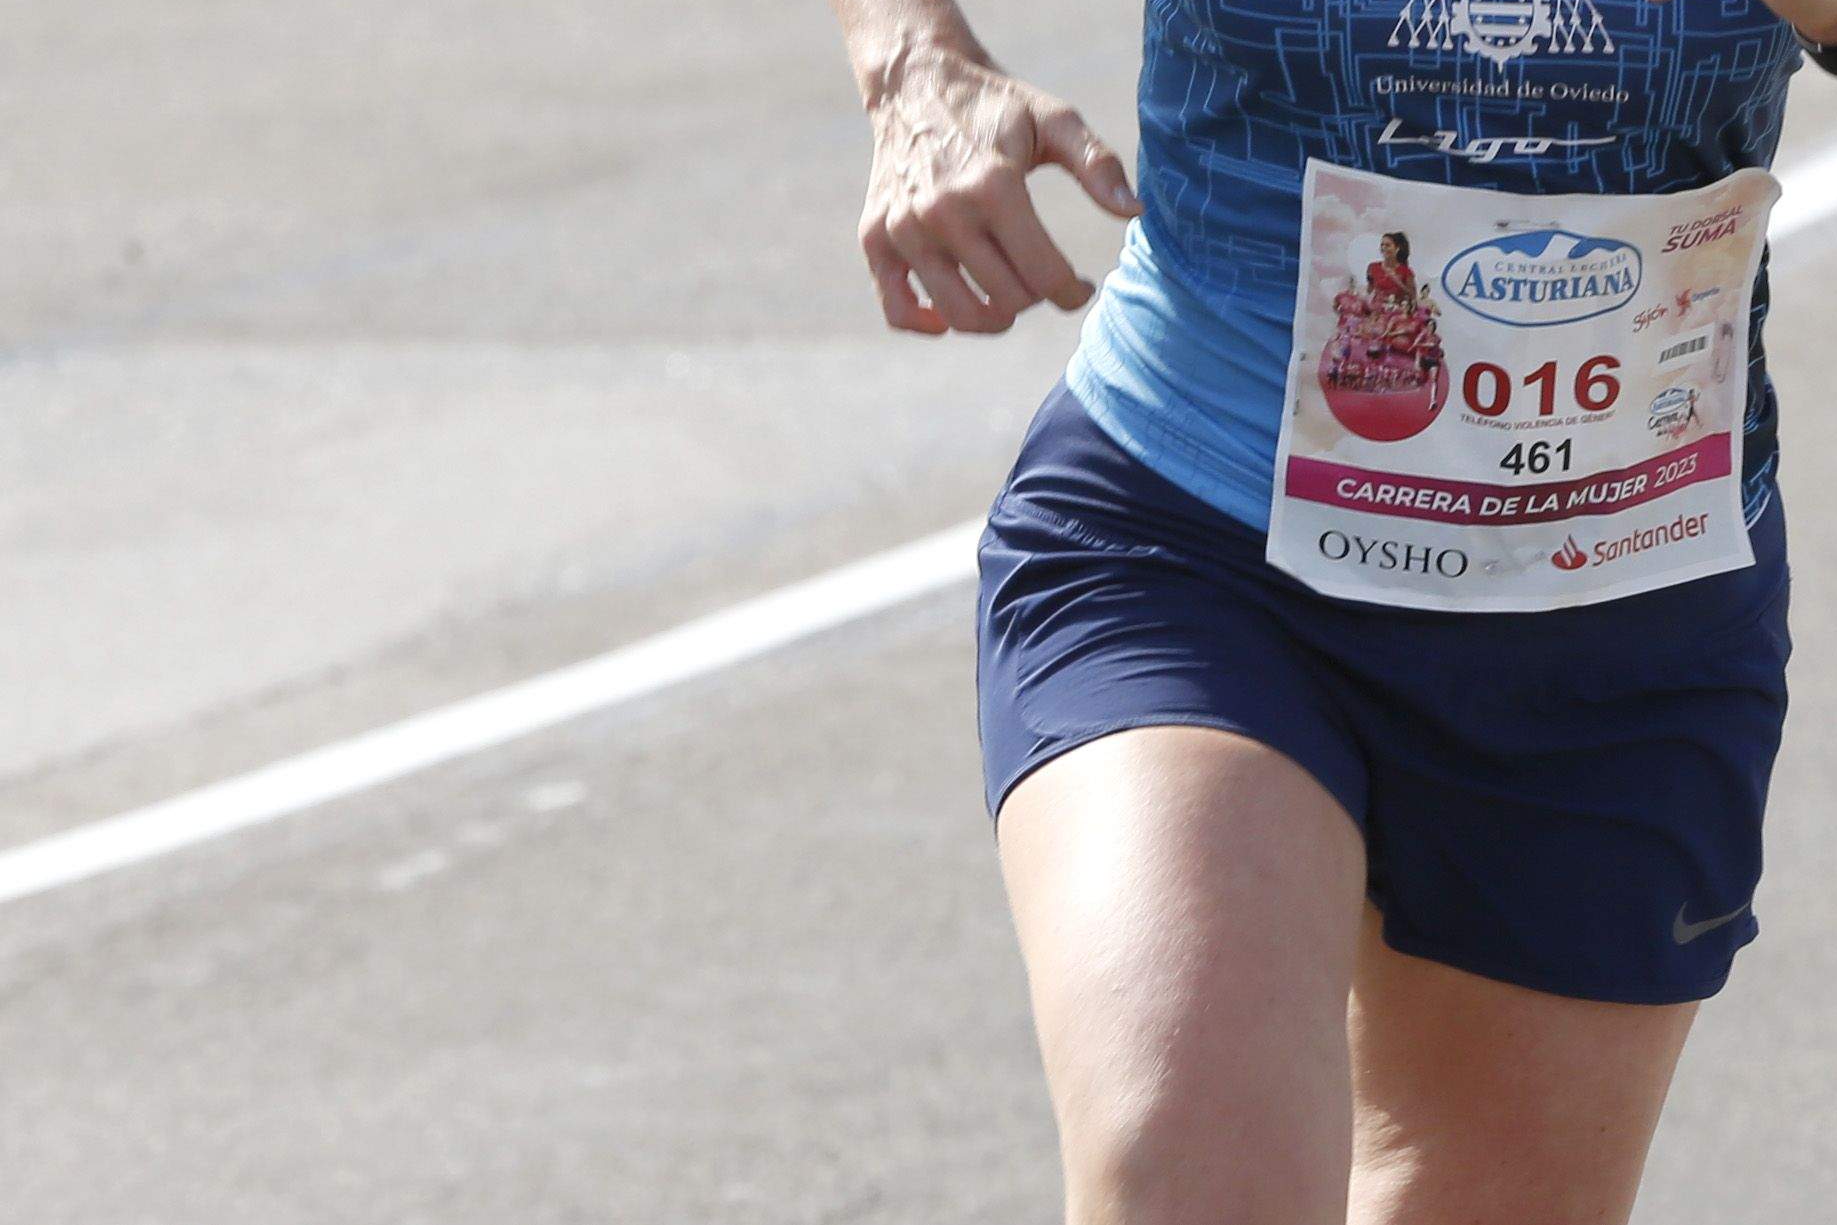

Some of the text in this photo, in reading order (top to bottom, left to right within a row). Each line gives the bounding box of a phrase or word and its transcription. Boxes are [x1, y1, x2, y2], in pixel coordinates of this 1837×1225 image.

[1376, 75, 1629, 104] Universidad de Oviedo
[1661, 218, 1736, 253] SUMA
[1670, 205, 1743, 235] TU DORSAL
[1494, 260, 1563, 275] CENTRAL
[1463, 354, 1621, 417] 016
[1565, 416, 1579, 426] DE
[1500, 438, 1572, 475] 461
[1336, 452, 1698, 516] CARRERA DE LA MUJER 2023
[1318, 529, 1469, 579] OYSHO
[1592, 512, 1709, 567] Santander
